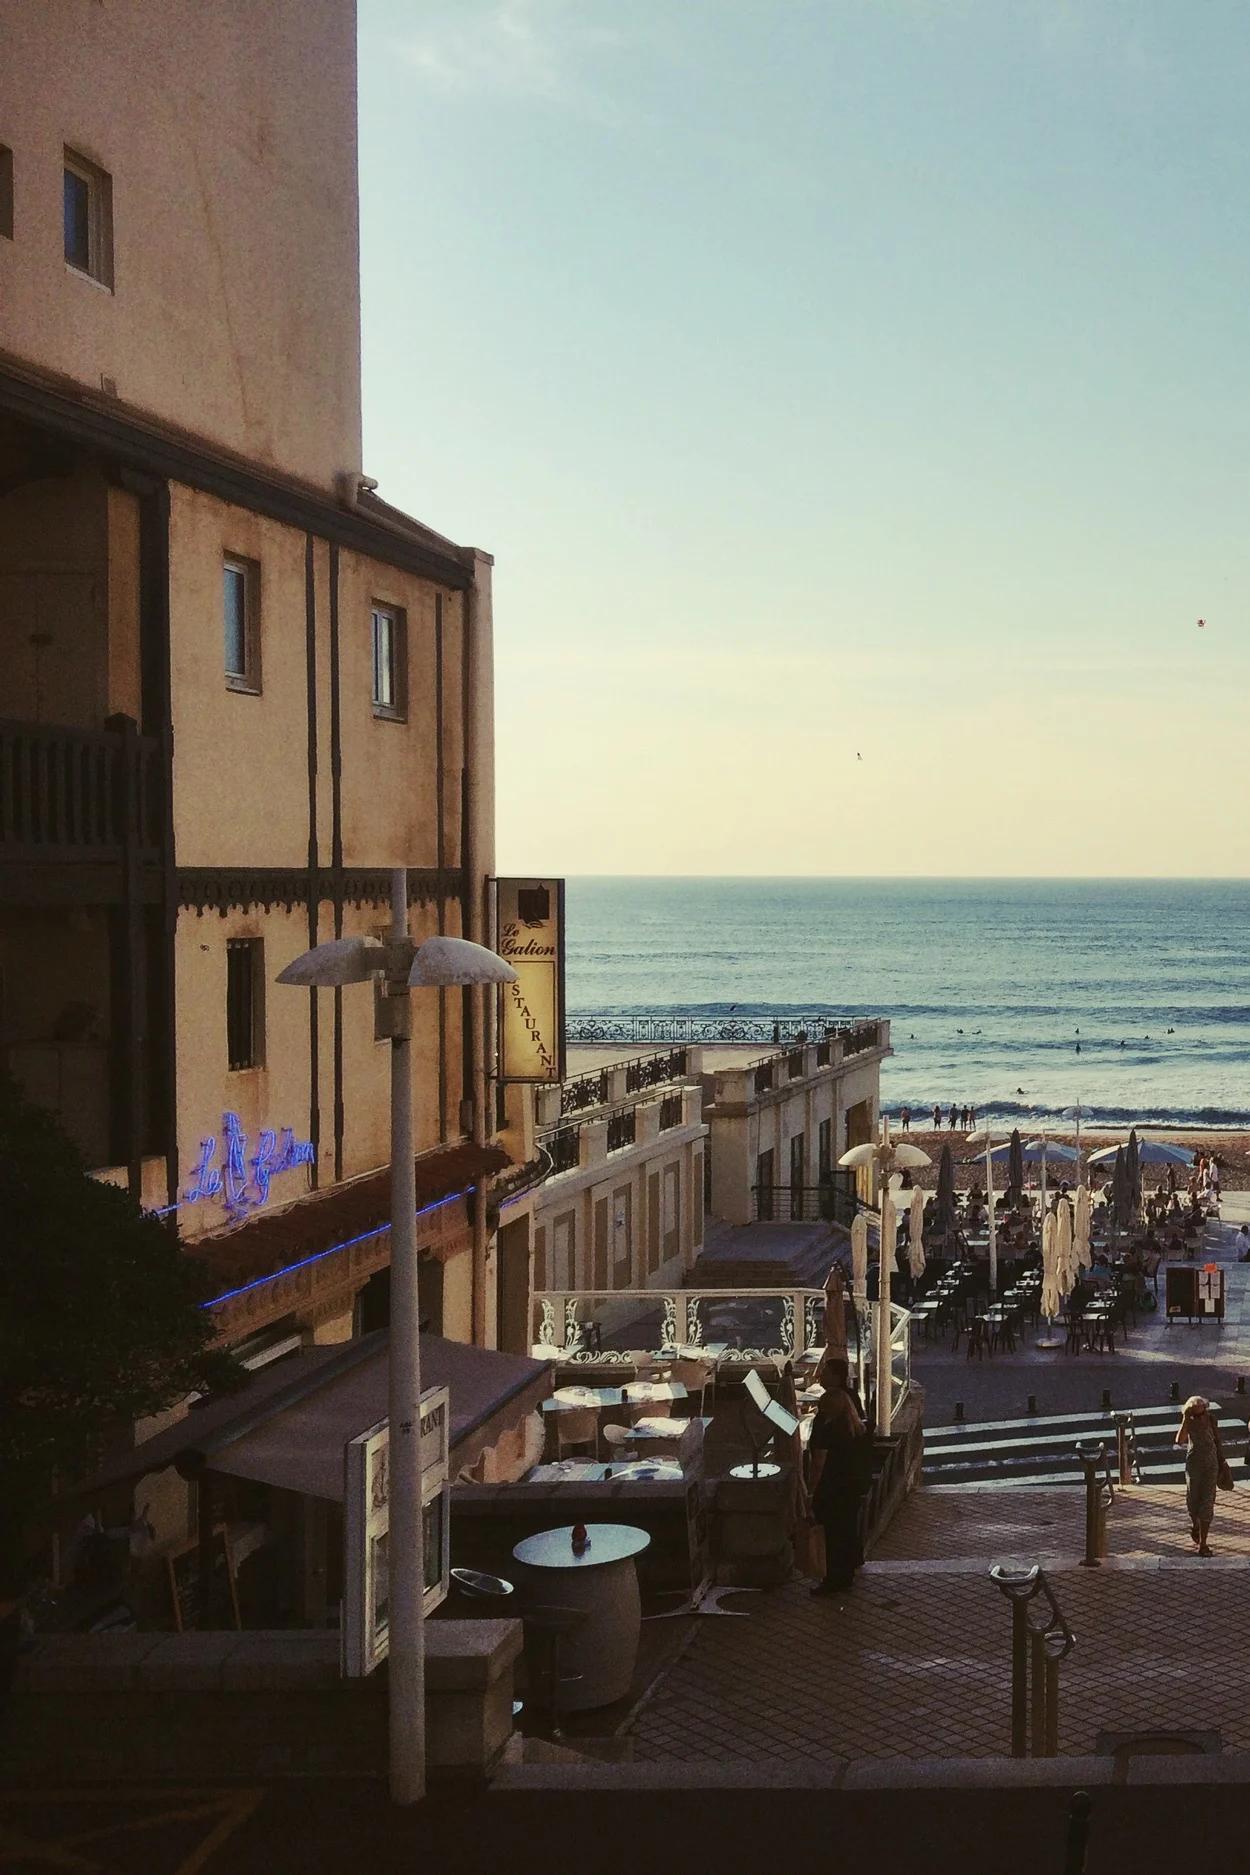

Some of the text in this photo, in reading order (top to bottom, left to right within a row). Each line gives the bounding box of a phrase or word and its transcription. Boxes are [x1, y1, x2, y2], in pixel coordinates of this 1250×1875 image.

[502, 923, 520, 937] Le
[501, 938, 556, 956] Galion
[505, 960, 556, 1079] STAURANT
